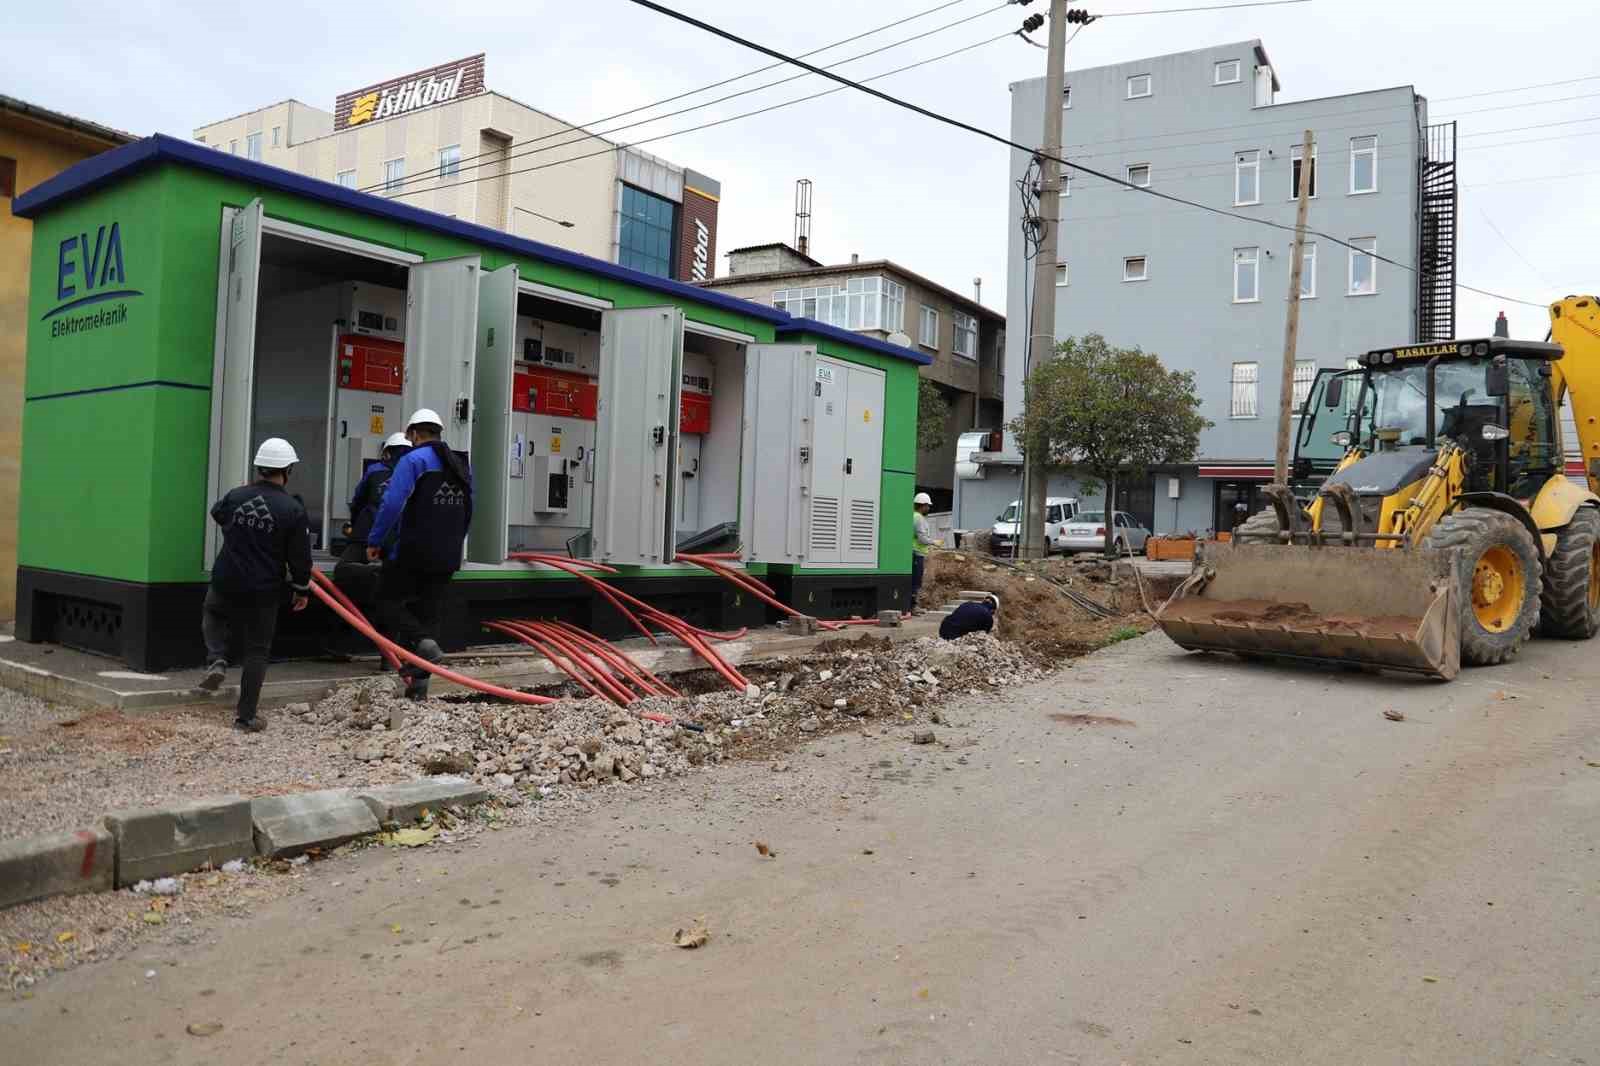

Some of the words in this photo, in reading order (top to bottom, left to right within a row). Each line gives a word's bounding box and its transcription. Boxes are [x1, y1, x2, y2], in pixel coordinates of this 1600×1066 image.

[375, 67, 464, 118] istikbal
[57, 222, 125, 300] EVA
[51, 303, 127, 337] Elektromekanik
